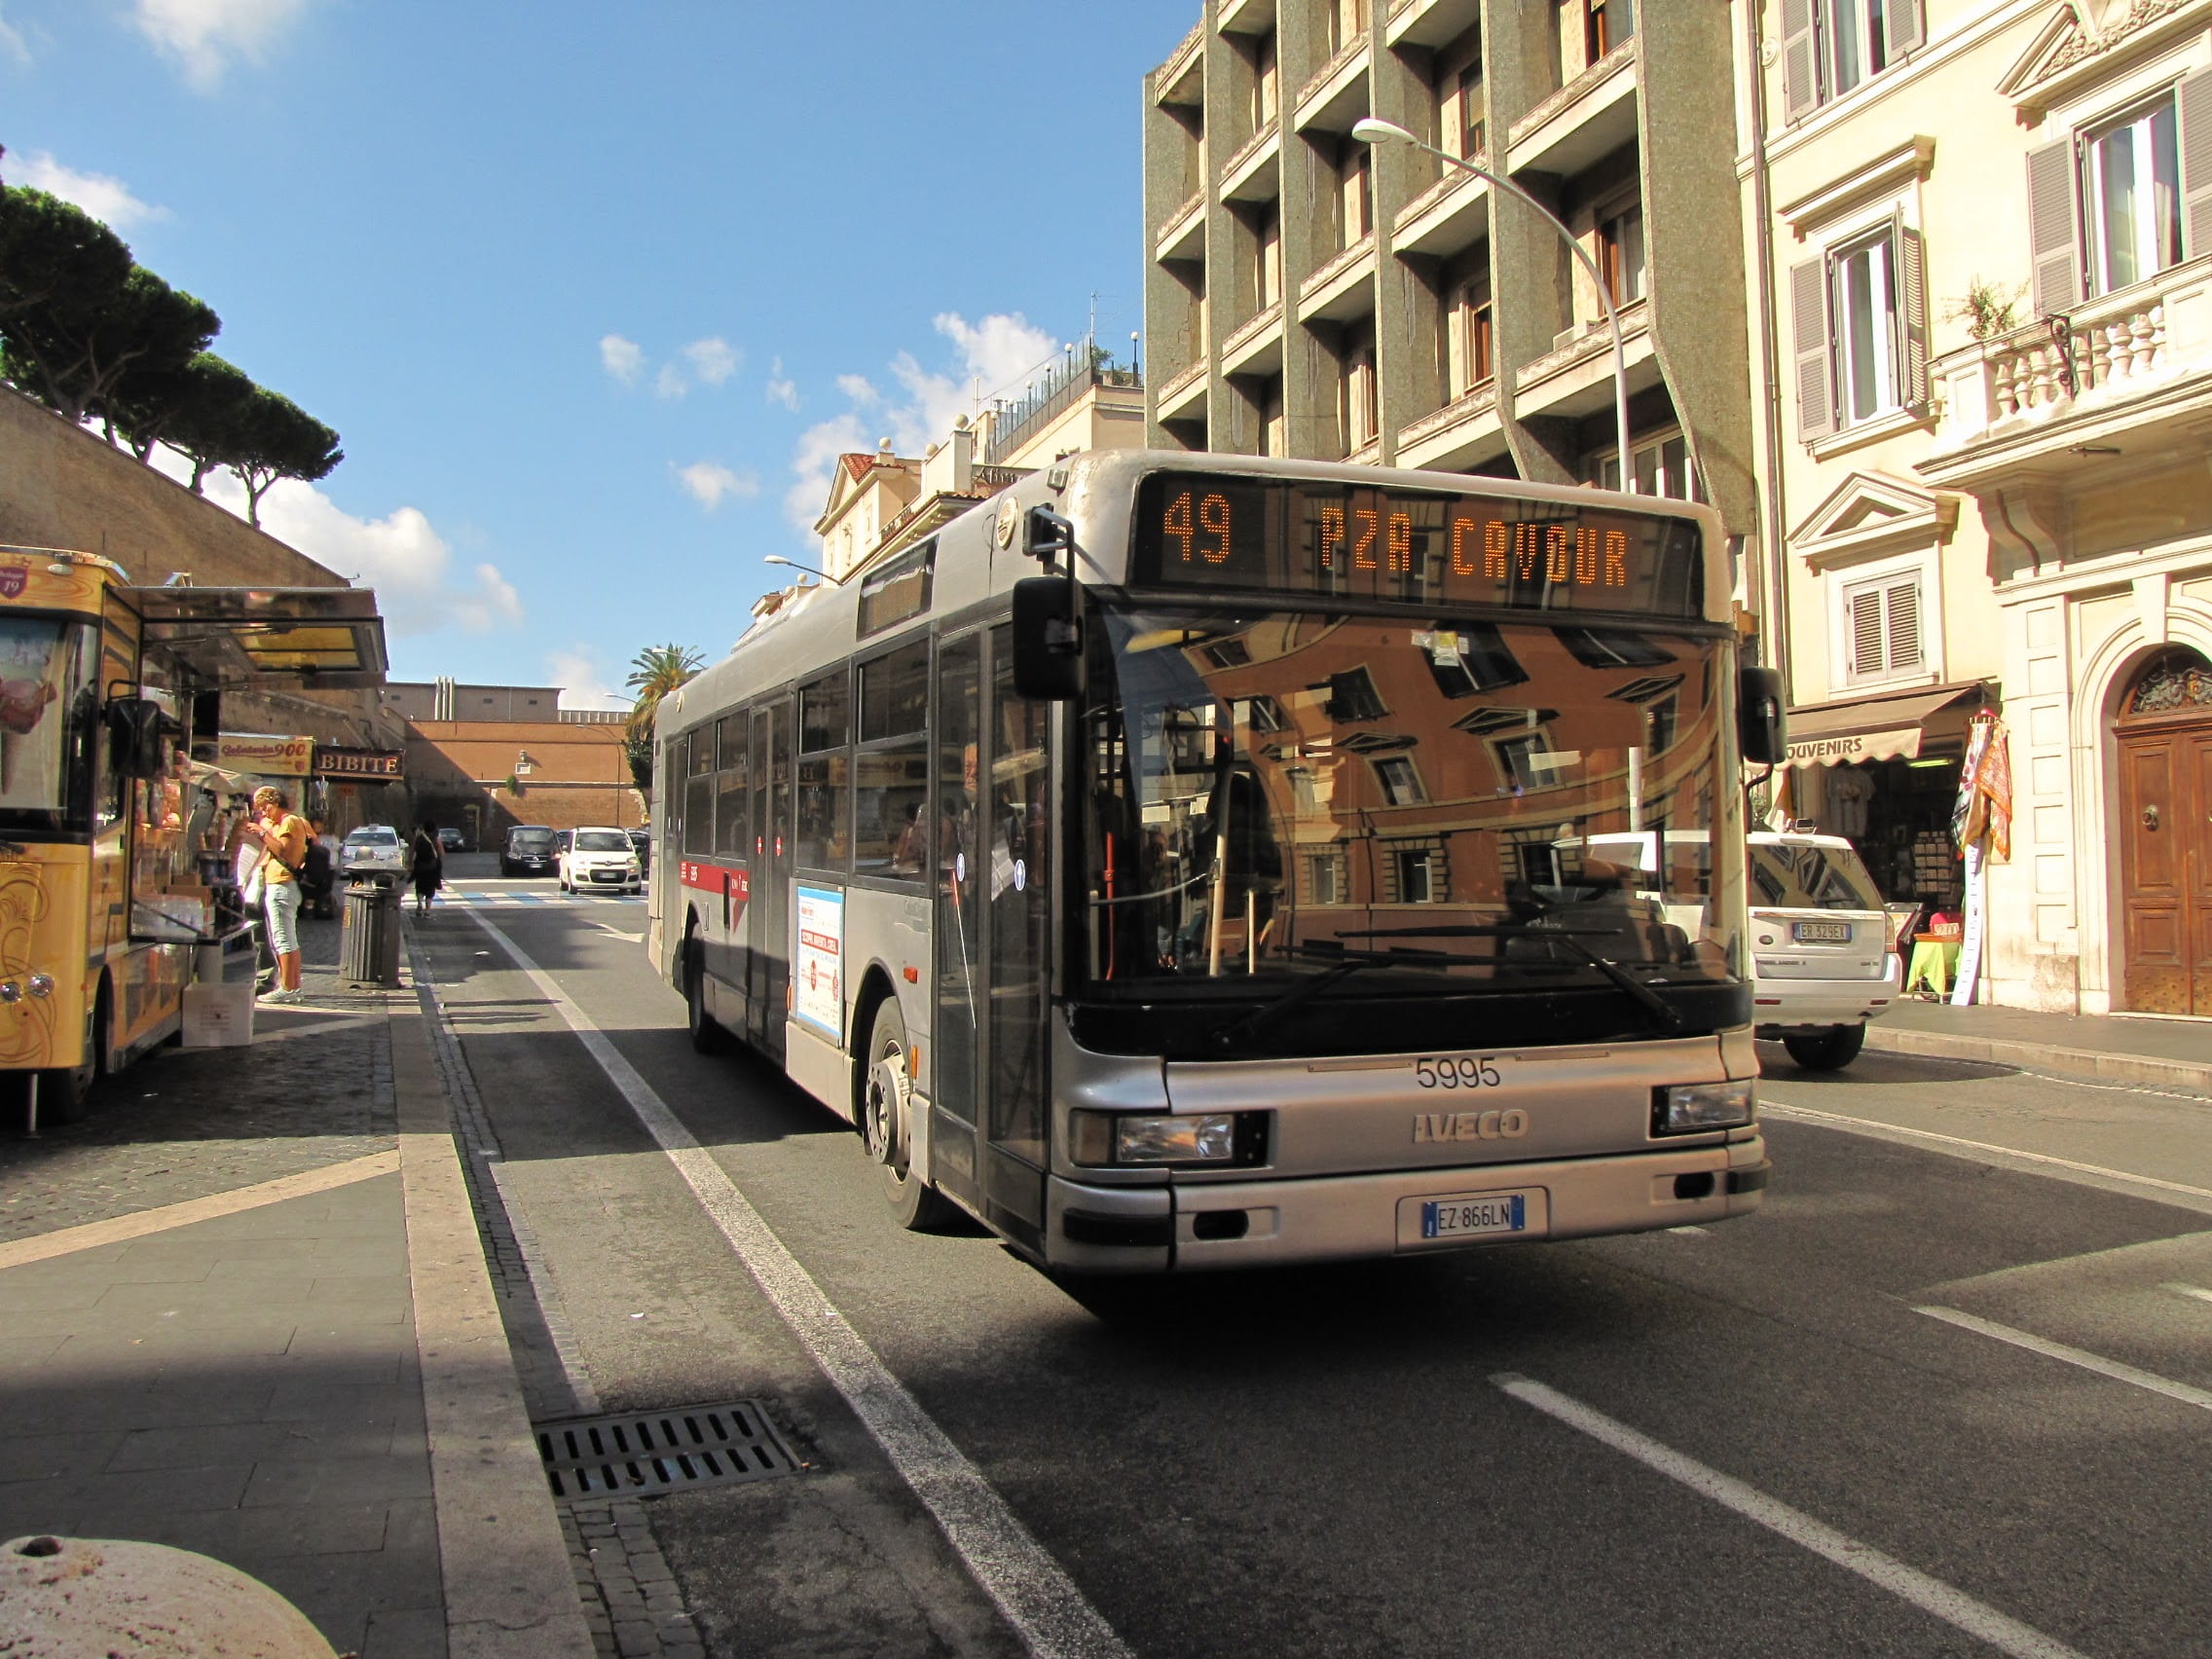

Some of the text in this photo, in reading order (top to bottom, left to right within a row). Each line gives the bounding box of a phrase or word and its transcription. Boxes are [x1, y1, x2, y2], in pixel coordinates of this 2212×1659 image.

[1162, 491, 1626, 586] 49 PZA CAVOUR
[276, 743, 307, 757] 900
[1786, 737, 1862, 759] OUVENIRS
[319, 755, 398, 774] BIBITE
[1416, 1056, 1500, 1088] 5995
[1414, 1108, 1530, 1144] IVECO
[1438, 1207, 1457, 1230] EZ
[1462, 1203, 1510, 1227] 866LN
